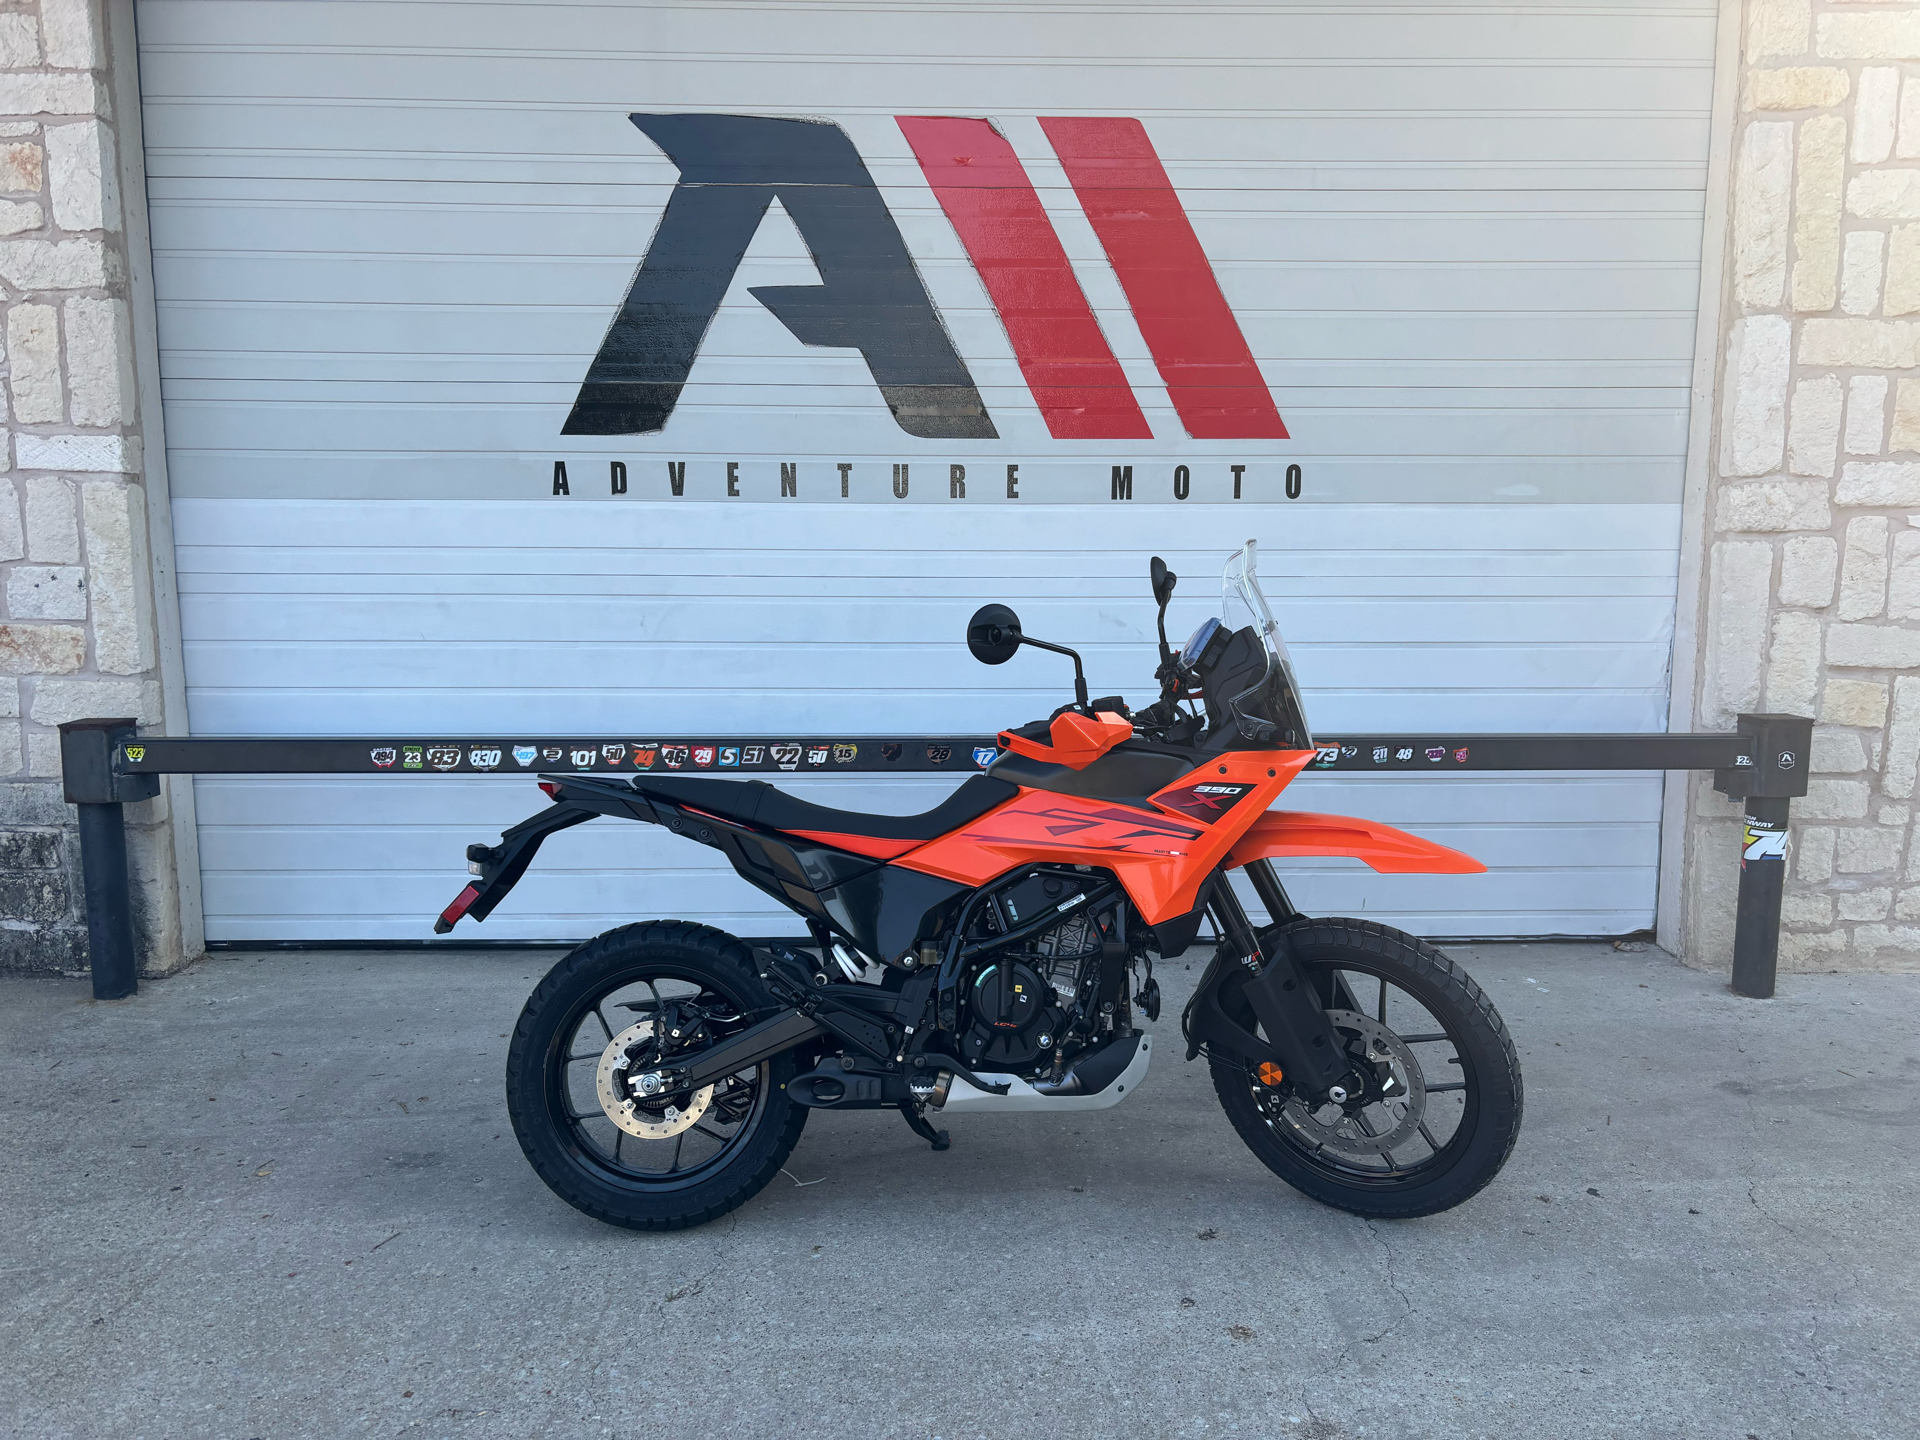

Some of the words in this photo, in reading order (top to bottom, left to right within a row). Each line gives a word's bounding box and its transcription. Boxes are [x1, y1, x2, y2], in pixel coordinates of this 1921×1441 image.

[552, 460, 1019, 499] ADVENTURE
[1110, 463, 1303, 501] MOTO
[127, 747, 144, 758] 523
[404, 752, 421, 763] 23
[430, 750, 460, 766] 83
[470, 750, 502, 766] 830
[570, 751, 597, 766] 101
[605, 748, 623, 761] 50
[664, 750, 686, 764] 46
[695, 749, 713, 763] 29
[721, 748, 737, 765] 5
[741, 746, 766, 764] 51
[775, 748, 799, 765] 22
[808, 750, 828, 764] 50
[839, 749, 852, 758] 15
[977, 752, 995, 765] 17
[1316, 748, 1339, 761] 73
[1396, 748, 1413, 760] 48
[1193, 786, 1242, 795] 390
